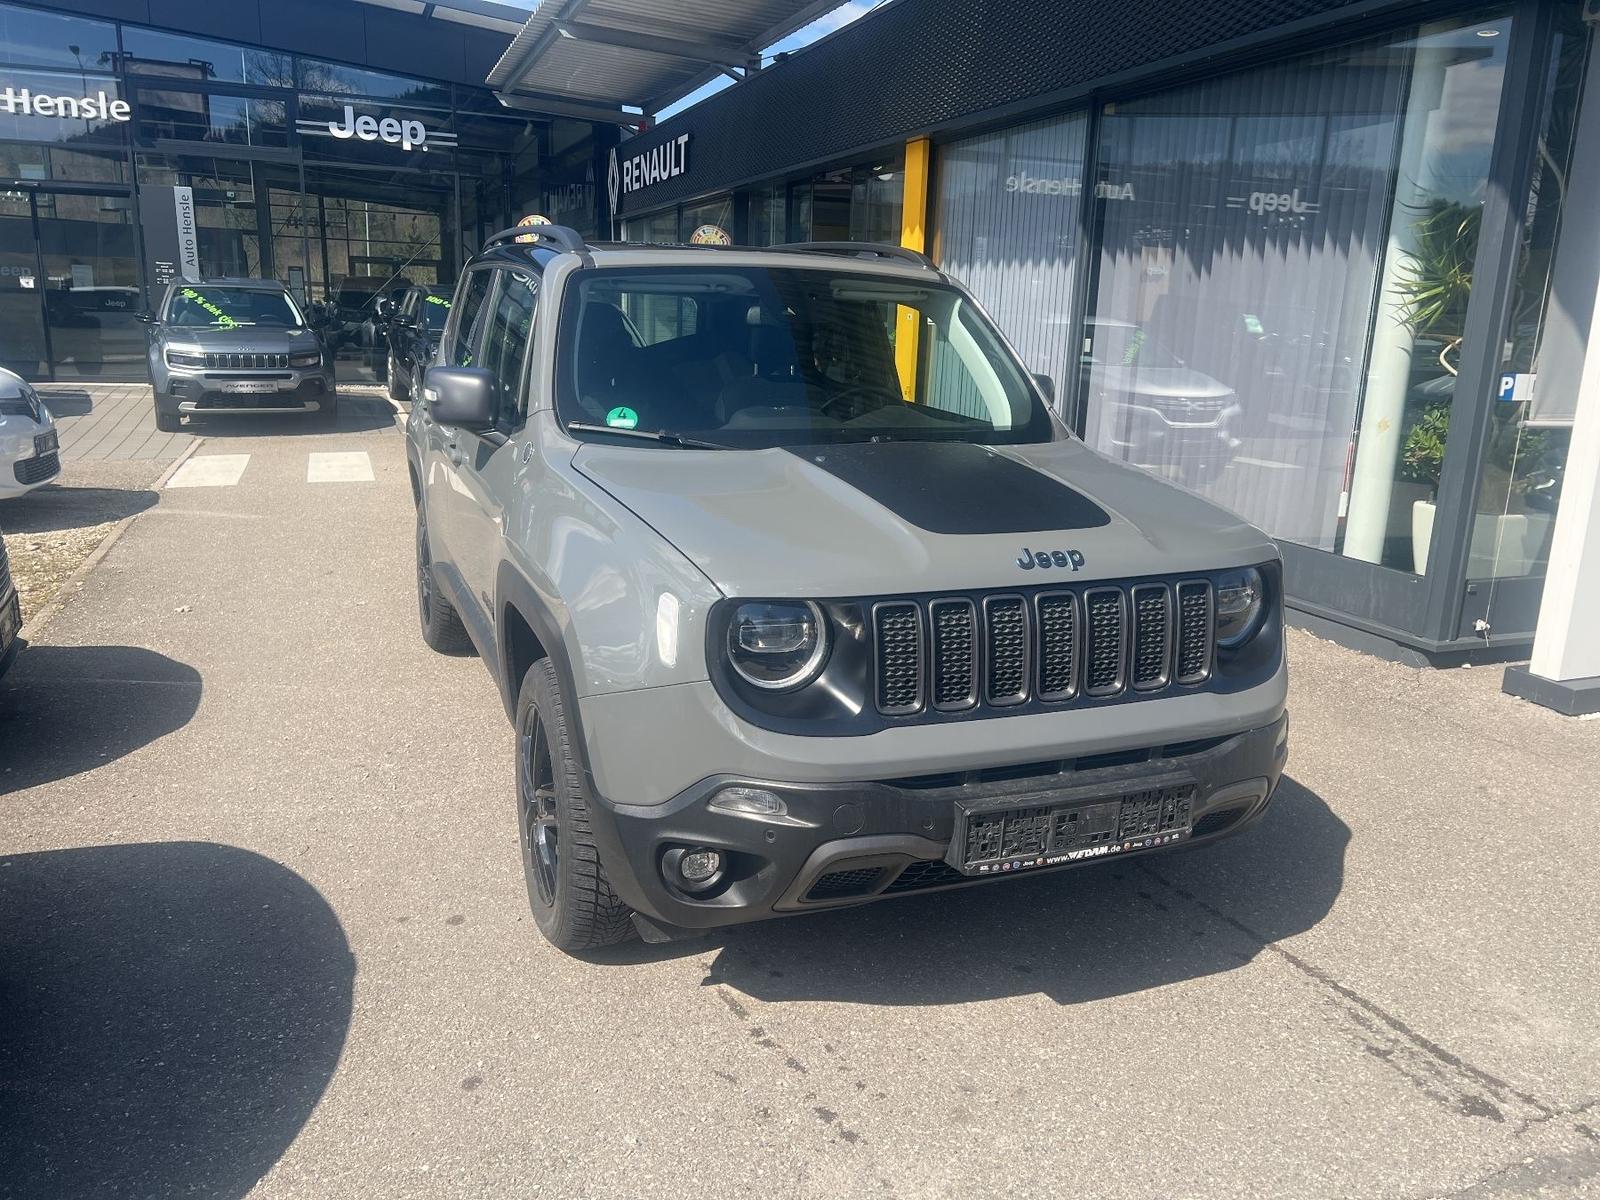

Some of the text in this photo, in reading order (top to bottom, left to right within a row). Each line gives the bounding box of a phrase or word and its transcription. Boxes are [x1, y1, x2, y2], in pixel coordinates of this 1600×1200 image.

[5, 87, 131, 121] Hensle
[328, 105, 427, 151] Jeep
[623, 133, 689, 194] RENAULT
[179, 194, 196, 267] Auto Hensle
[1498, 376, 1515, 397] P
[617, 407, 627, 419] 4
[1016, 547, 1085, 572] Jeep
